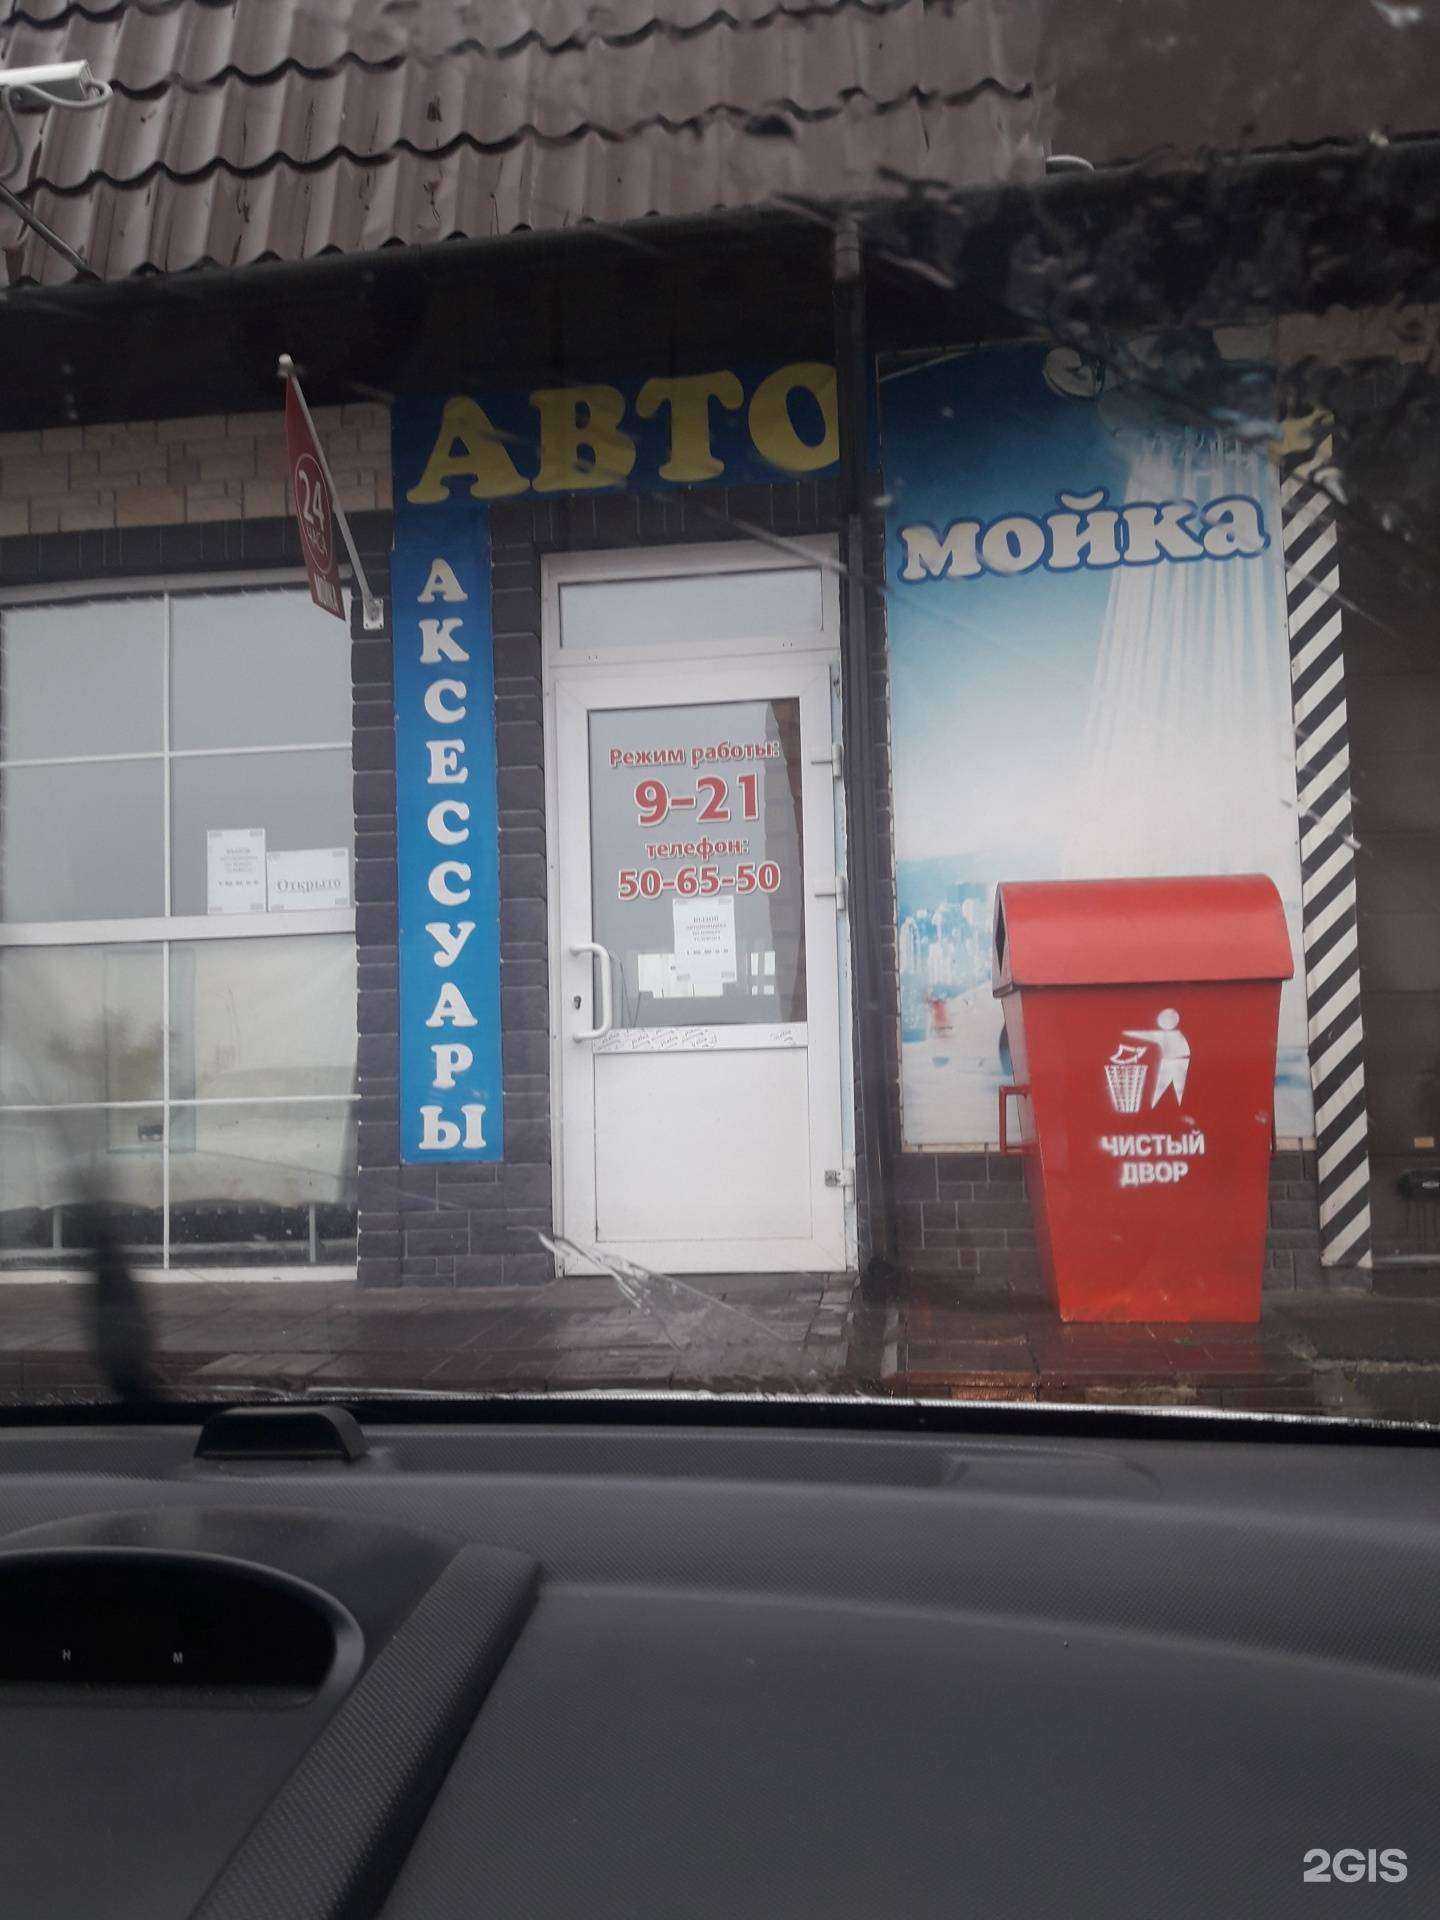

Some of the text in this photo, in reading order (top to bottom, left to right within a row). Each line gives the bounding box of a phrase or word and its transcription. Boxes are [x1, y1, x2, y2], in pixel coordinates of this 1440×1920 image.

[406, 361, 840, 504] АВТО
[299, 469, 325, 531] 24
[608, 740, 781, 769] Режим работы:
[417, 557, 488, 1150] АКСЕССУАРЫ
[645, 836, 750, 861] телефон:
[276, 878, 342, 894] Открыто
[617, 860, 782, 902] 50-65-50
[1099, 1130, 1206, 1158] ЧИСТЫЙ
[1119, 1161, 1189, 1188] ДВОР
